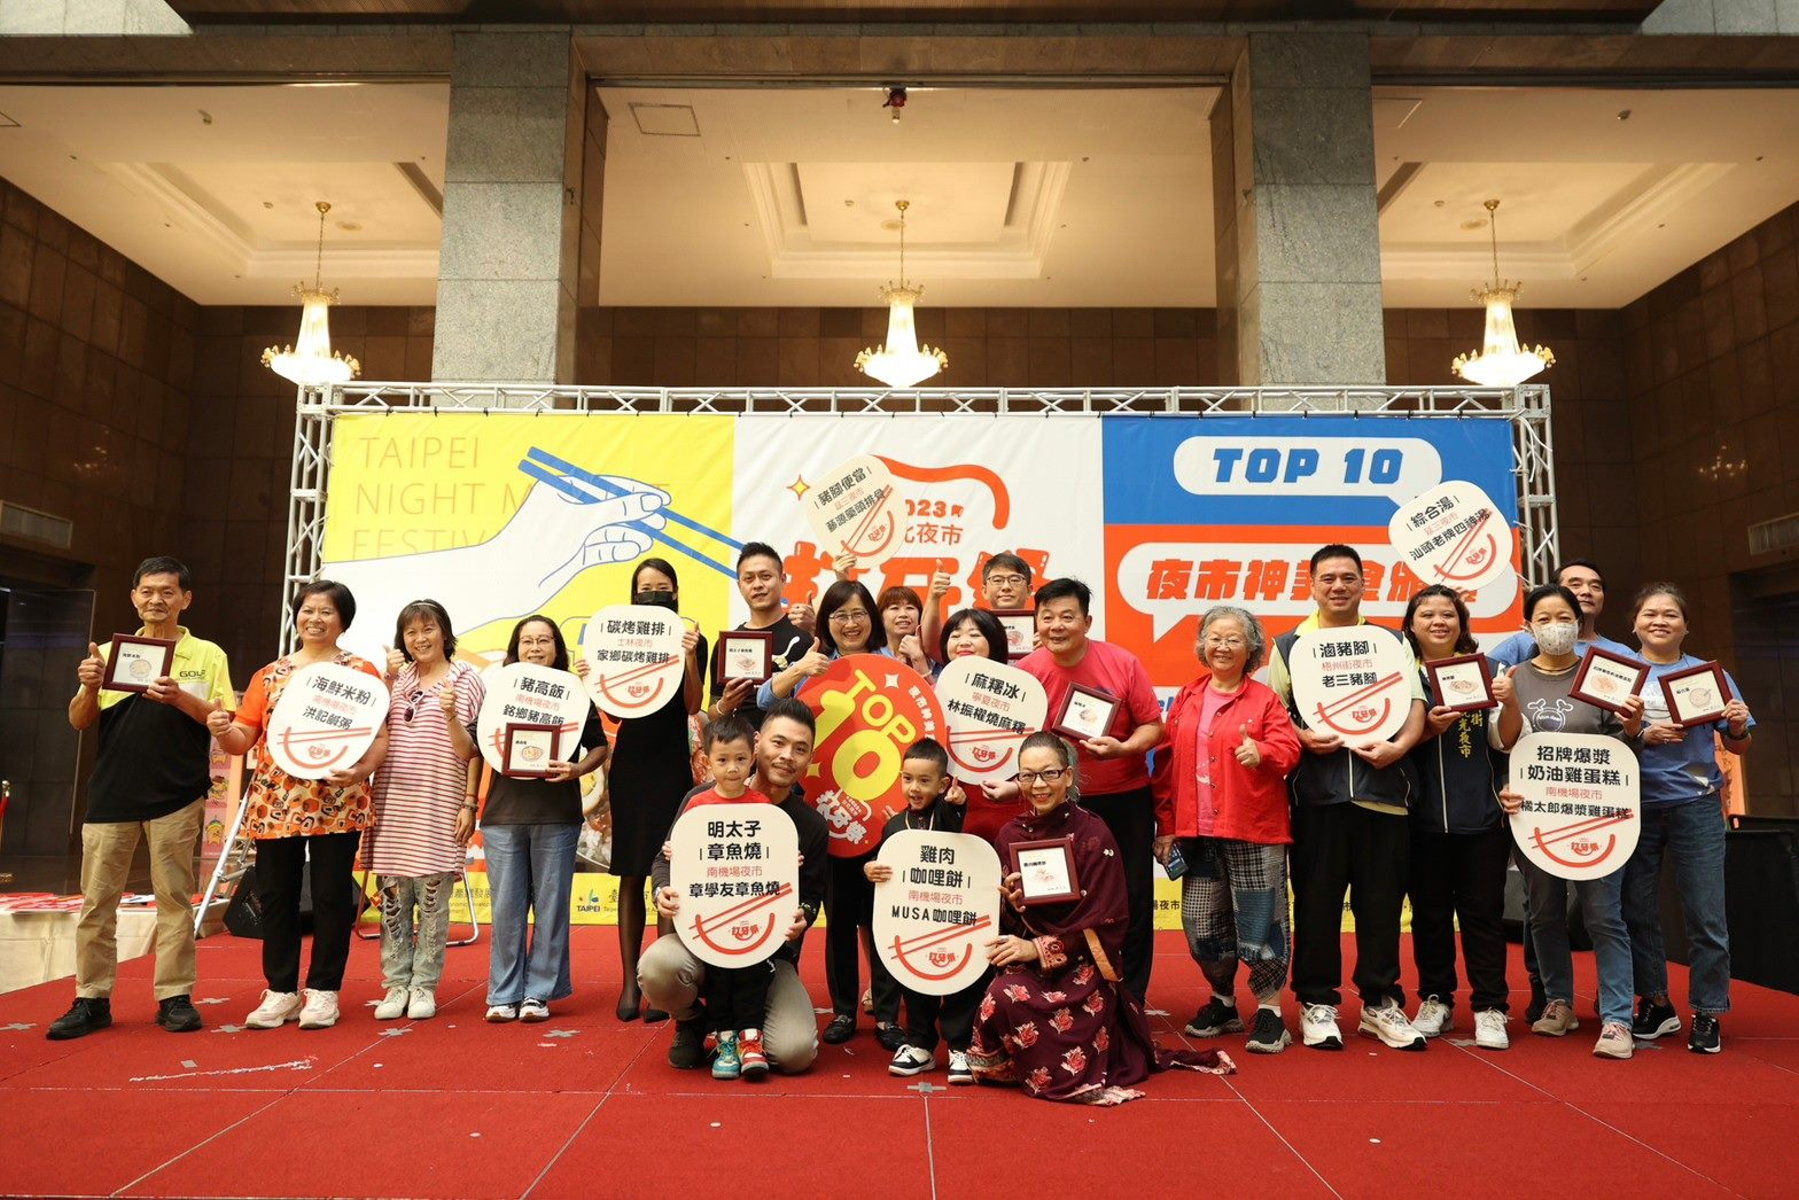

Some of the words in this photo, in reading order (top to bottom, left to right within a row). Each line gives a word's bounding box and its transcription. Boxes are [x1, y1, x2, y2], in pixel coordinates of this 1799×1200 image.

[360, 437, 479, 469] TAIPEI
[1213, 448, 1320, 484] TOP
[1344, 448, 1404, 484] 10
[356, 483, 486, 515] NIGHT
[1410, 496, 1454, 528] 綜合湯
[607, 620, 665, 636] 碳烤雞排
[597, 649, 670, 664] 家鄉碳烤雞排
[1319, 641, 1370, 658] 滷豬腳
[520, 676, 565, 699] 豬高飯
[971, 673, 1020, 699] 麻糬冰
[1322, 672, 1378, 688] 老三豬腳
[312, 676, 372, 705] 海鮮米粉
[503, 704, 565, 725] 銘鄉豬高飯
[854, 669, 917, 744] TOP
[302, 705, 353, 730] 洪記鹹粥
[1537, 745, 1611, 765] 招牌爆漿
[1527, 765, 1621, 786] 奶油雞蛋糕
[1545, 786, 1603, 800] 南機場夜市
[708, 820, 762, 838] 明太子
[708, 842, 762, 861] 章魚燒
[920, 845, 955, 865] 雞肉
[706, 866, 762, 878] 南機場夜市
[910, 867, 963, 888] 咖哩餅
[689, 881, 780, 898] 章學友章魚燒
[908, 889, 964, 906] 南機場夜市
[577, 904, 601, 913] TAIPEI
[892, 905, 929, 921] MUSA
[932, 909, 977, 927] 咖哩餅
